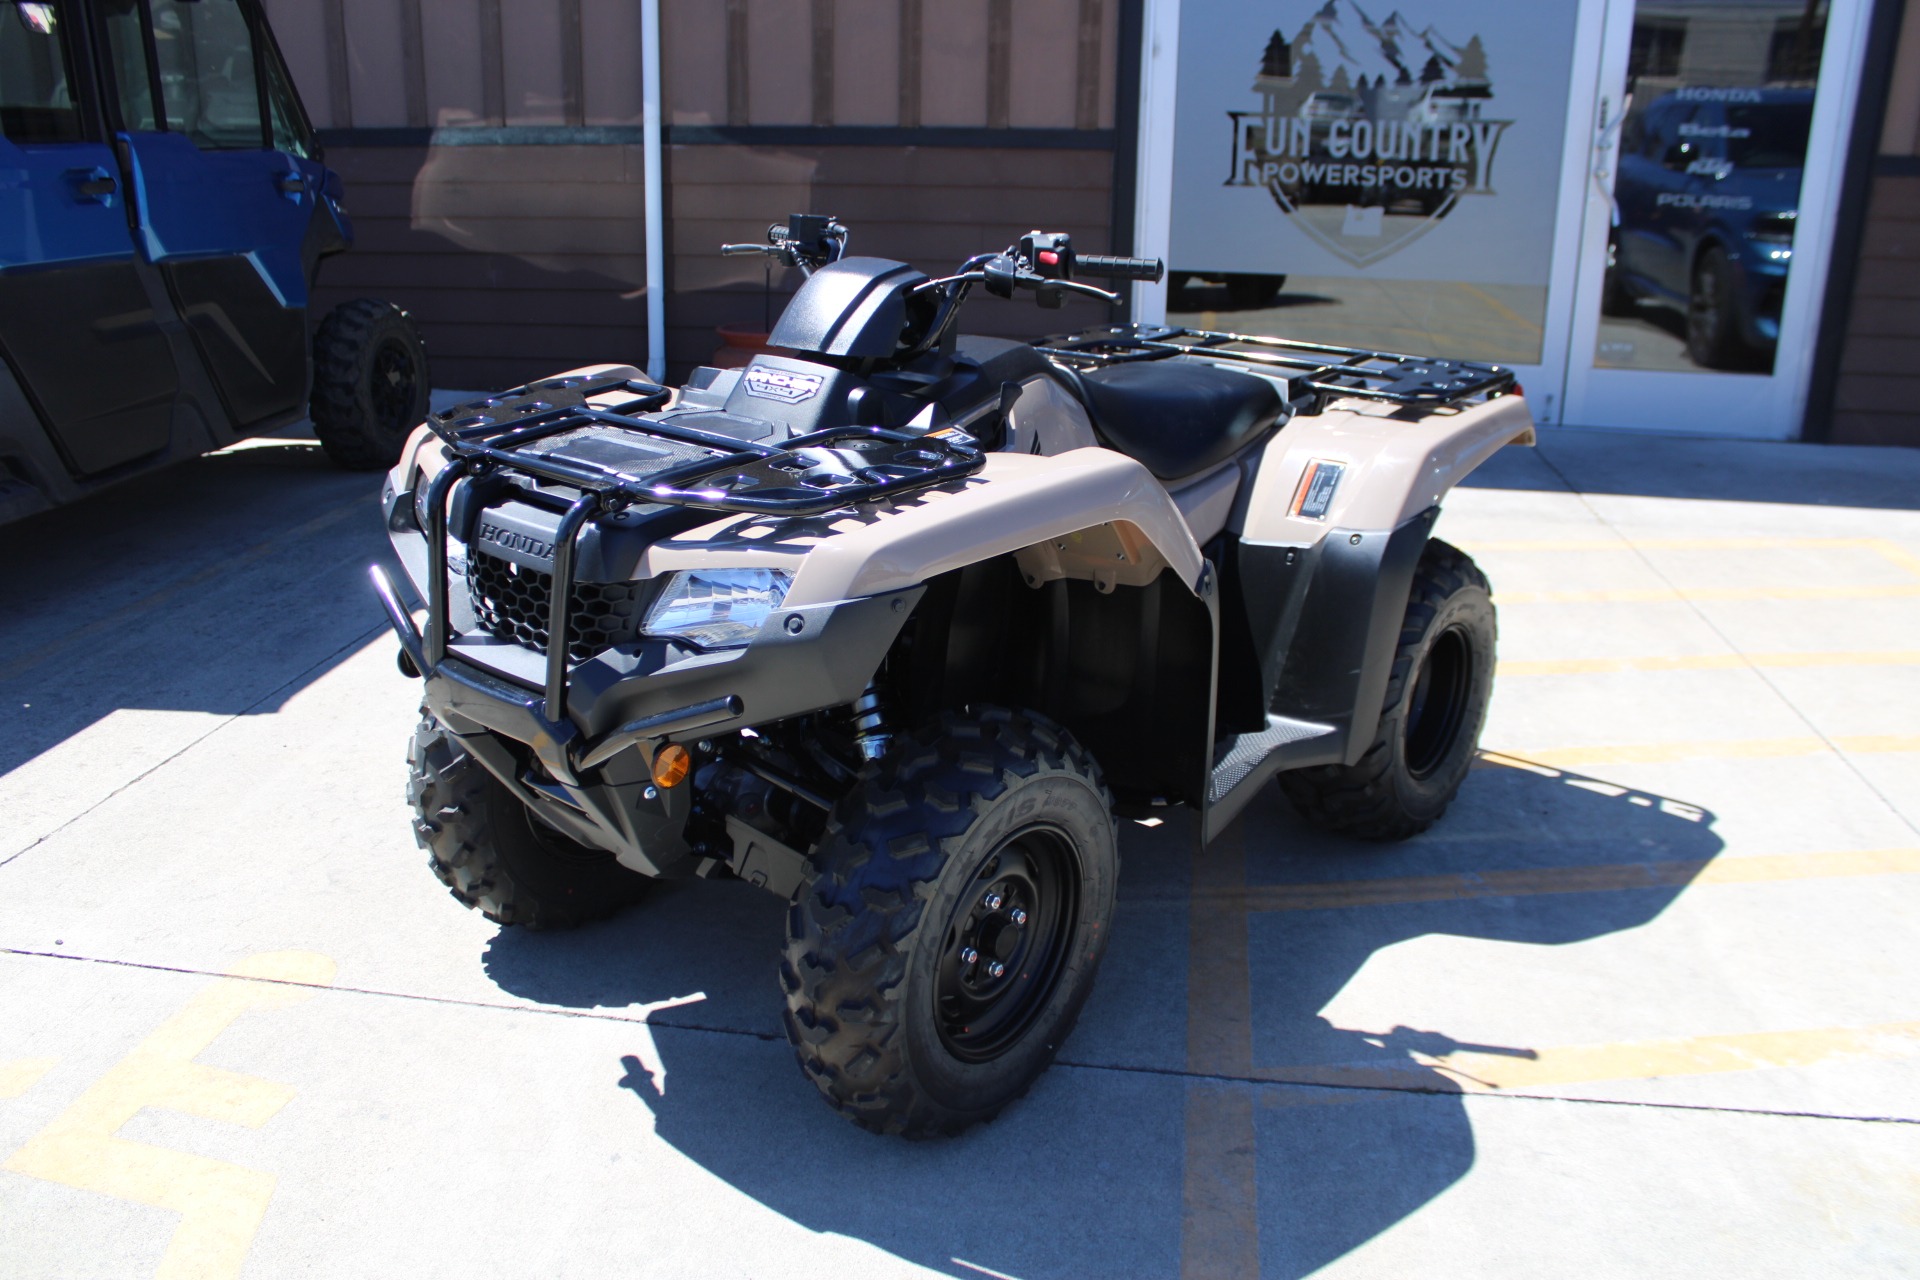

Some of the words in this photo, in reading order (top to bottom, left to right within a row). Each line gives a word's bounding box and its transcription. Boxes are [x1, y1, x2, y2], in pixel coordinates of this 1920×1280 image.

[1676, 87, 1761, 103] HONDA
[1677, 122, 1752, 138] Beta
[1224, 112, 1311, 186] FUN
[1328, 118, 1512, 194] COUNTRY
[1262, 163, 1467, 190] POWERSPORTS
[1685, 157, 1734, 177] KTM
[1656, 193, 1753, 210] POLARIS
[479, 523, 555, 562] HONDA
